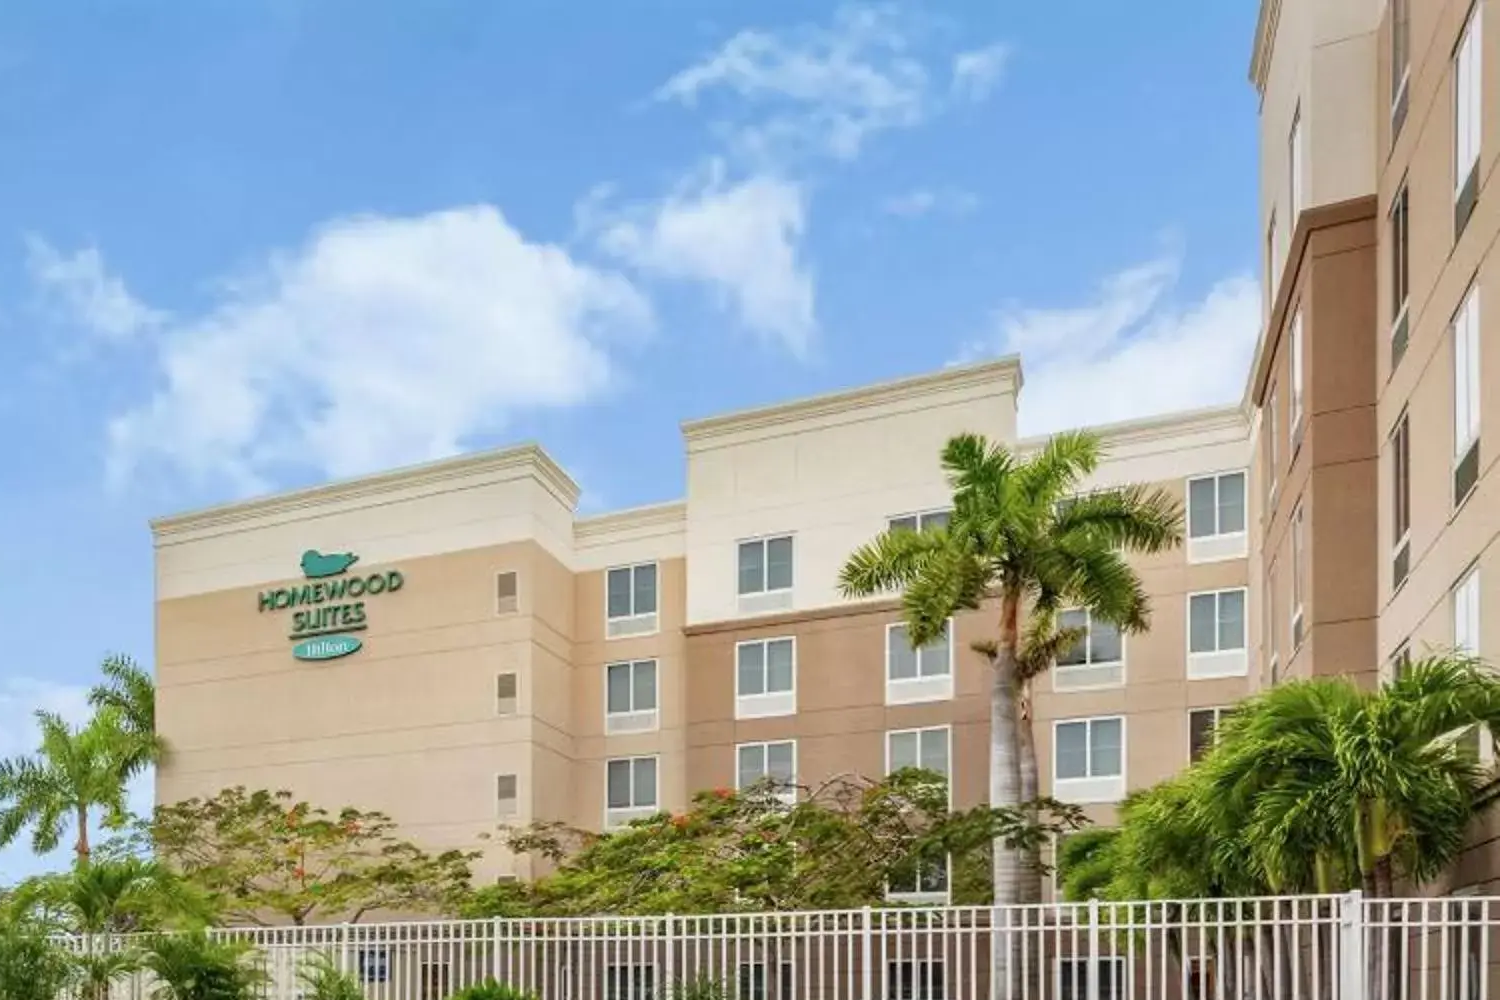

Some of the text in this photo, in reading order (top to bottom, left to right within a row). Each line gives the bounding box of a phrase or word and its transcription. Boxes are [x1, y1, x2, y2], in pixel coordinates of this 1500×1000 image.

[258, 570, 404, 612] HOMEWOOD
[292, 602, 366, 632] SUITES
[306, 640, 349, 657] Hilton
